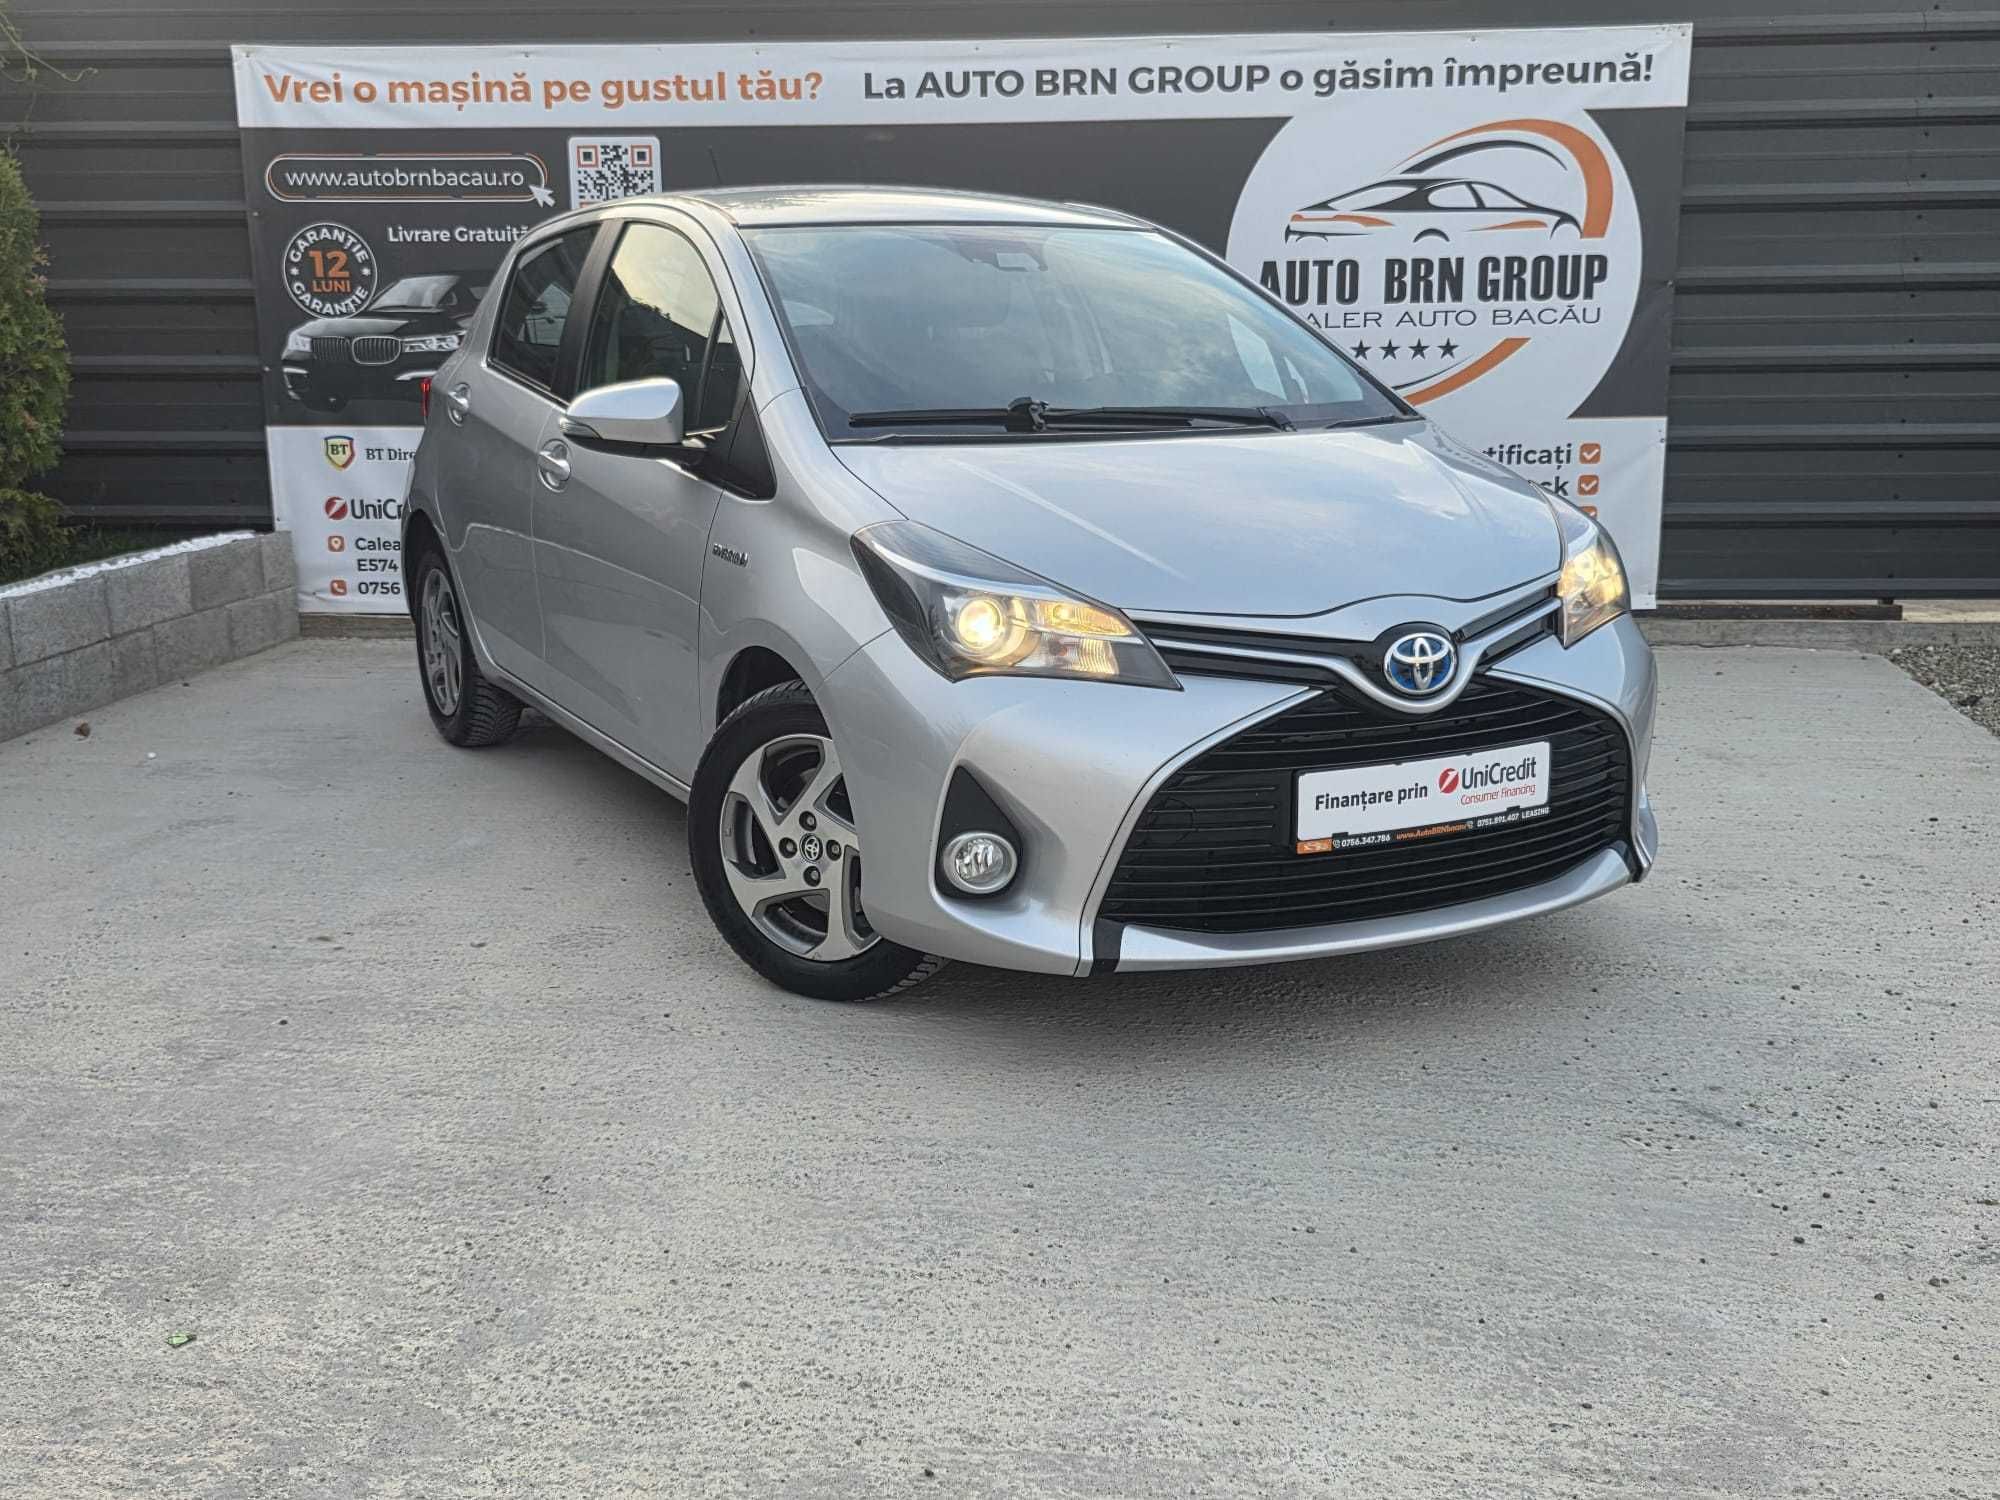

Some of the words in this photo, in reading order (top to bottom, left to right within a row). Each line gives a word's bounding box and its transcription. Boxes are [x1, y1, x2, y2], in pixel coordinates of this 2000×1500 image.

[864, 71, 905, 100] La
[915, 69, 1022, 100] AUTO
[1035, 67, 1117, 97] BRN
[1128, 64, 1270, 95] GROUP
[1280, 70, 1301, 90] o
[1313, 57, 1434, 98] găsim
[1444, 54, 1654, 92] împreună!
[264, 69, 344, 104] Vrei
[353, 81, 377, 103] o
[388, 71, 532, 112] mașină
[543, 79, 591, 109] pe
[601, 72, 726, 109] gustul
[737, 70, 823, 102] tău?
[285, 168, 524, 187] www.autobrnbacau.ro
[387, 226, 451, 242] Livrare
[308, 249, 350, 278] 12
[312, 279, 352, 293] LUNI
[1260, 258, 1360, 306] AUTO
[1383, 256, 1465, 305] BRN
[1477, 254, 1608, 303] GROUP
[1396, 309, 1477, 328] AUTO
[1492, 306, 1601, 326] BACĂU
[330, 444, 349, 456] BT
[366, 448, 385, 461] BT
[1482, 443, 1572, 470] tificați
[354, 537, 401, 551] Calea
[357, 558, 398, 572] E574
[358, 582, 401, 595] 0756
[1461, 757, 1537, 790] UniCredit
[1315, 789, 1394, 811] Finanțare
[1398, 782, 1428, 805] prin
[1460, 790, 1499, 805] Consumer
